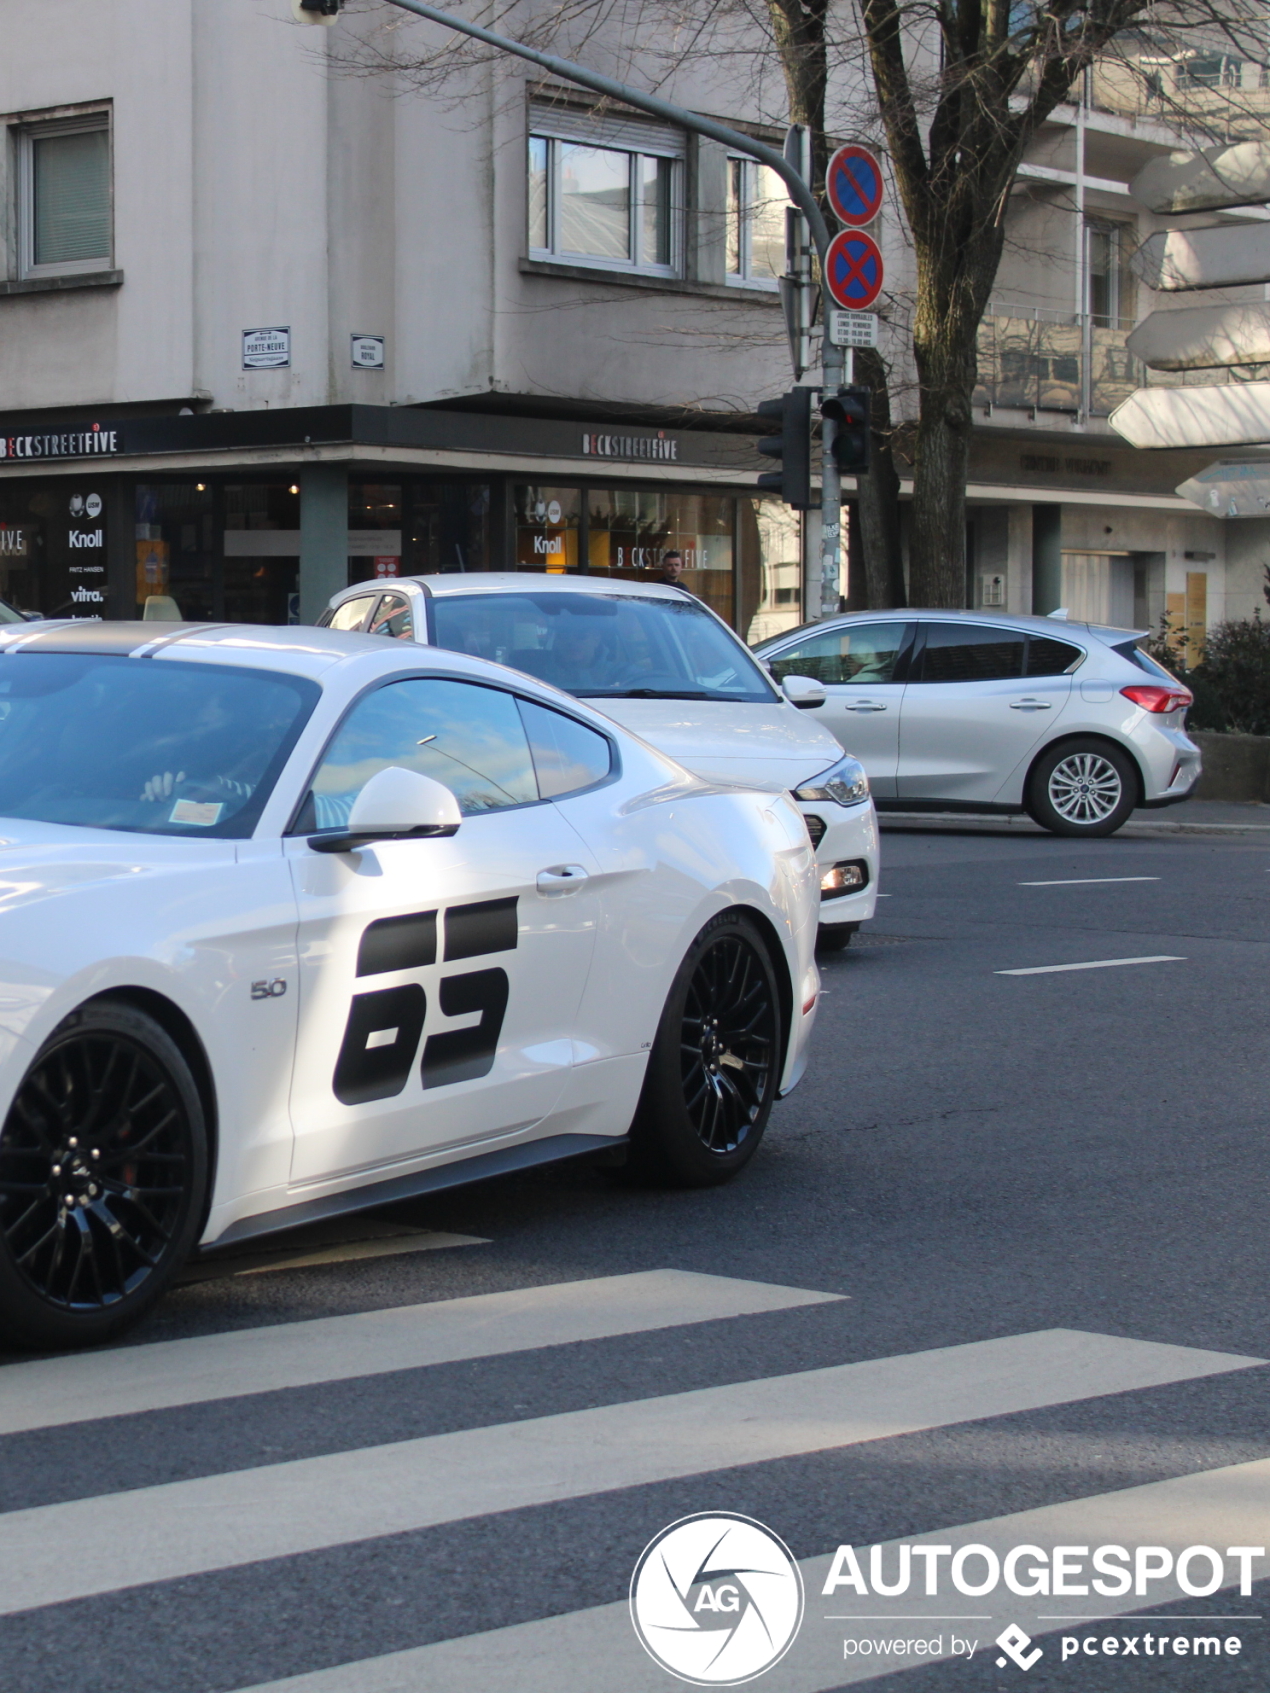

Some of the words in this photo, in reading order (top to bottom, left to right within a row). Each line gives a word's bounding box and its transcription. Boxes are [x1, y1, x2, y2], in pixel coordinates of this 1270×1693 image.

[247, 342, 285, 352] PORTE-NEUVE
[361, 352, 375, 360] ROYAL
[583, 431, 677, 460] BECKSTREETFIVE
[69, 530, 102, 548] Knoll
[534, 536, 561, 553] Knoll
